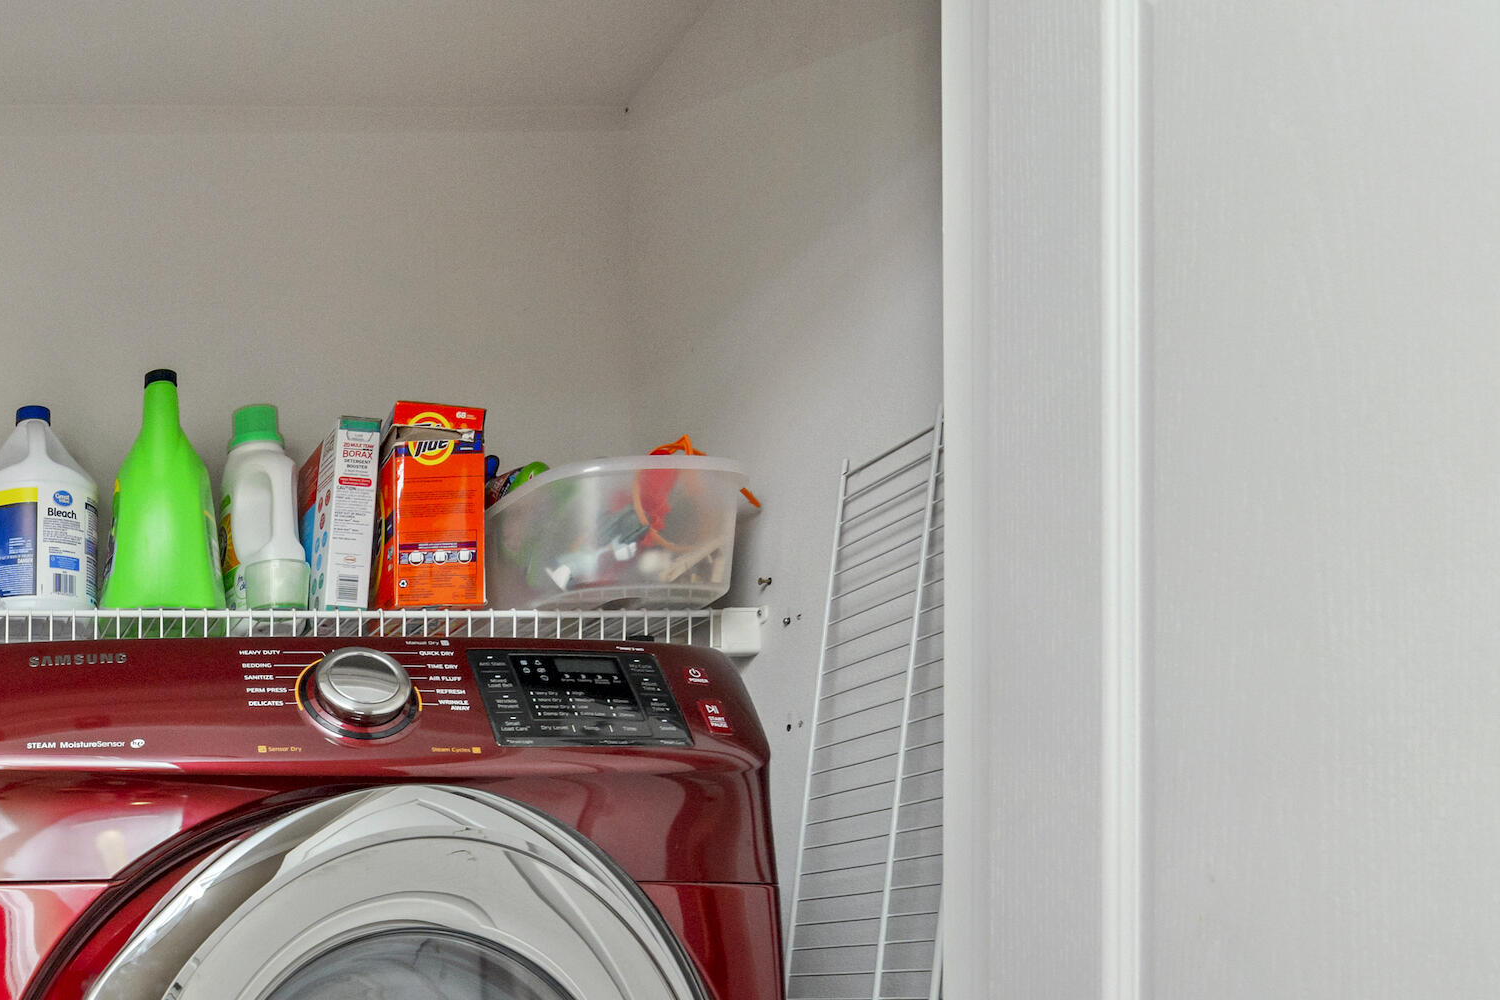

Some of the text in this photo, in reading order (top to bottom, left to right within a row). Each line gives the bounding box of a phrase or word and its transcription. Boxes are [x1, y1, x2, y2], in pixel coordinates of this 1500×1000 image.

[456, 411, 467, 419] 68
[342, 450, 373, 460] BORAX
[47, 507, 76, 519] Bleach
[29, 653, 127, 667] SAMSUNG
